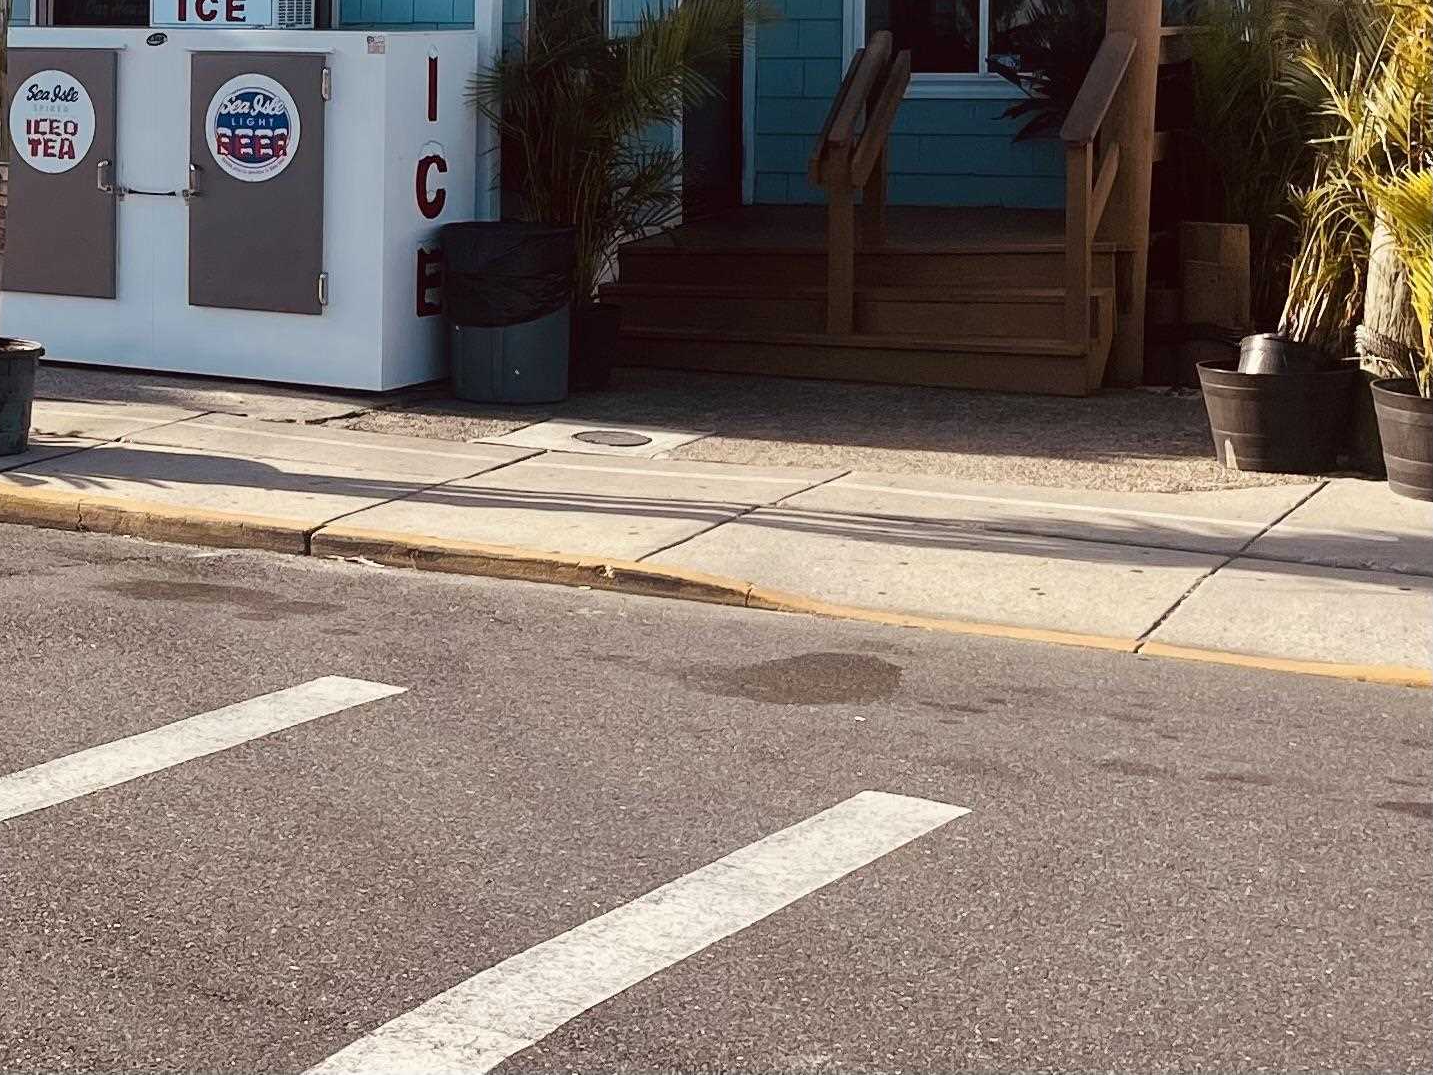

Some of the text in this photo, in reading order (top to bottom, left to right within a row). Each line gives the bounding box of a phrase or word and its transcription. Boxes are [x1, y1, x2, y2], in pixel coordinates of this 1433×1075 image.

[26, 84, 79, 103] Sea Isle
[220, 94, 286, 116] Sea Isle
[26, 118, 79, 136] ICED
[231, 117, 275, 127] LIGHT
[27, 137, 76, 160] TEA
[216, 127, 288, 158] BEER
[416, 44, 448, 318] ICE
